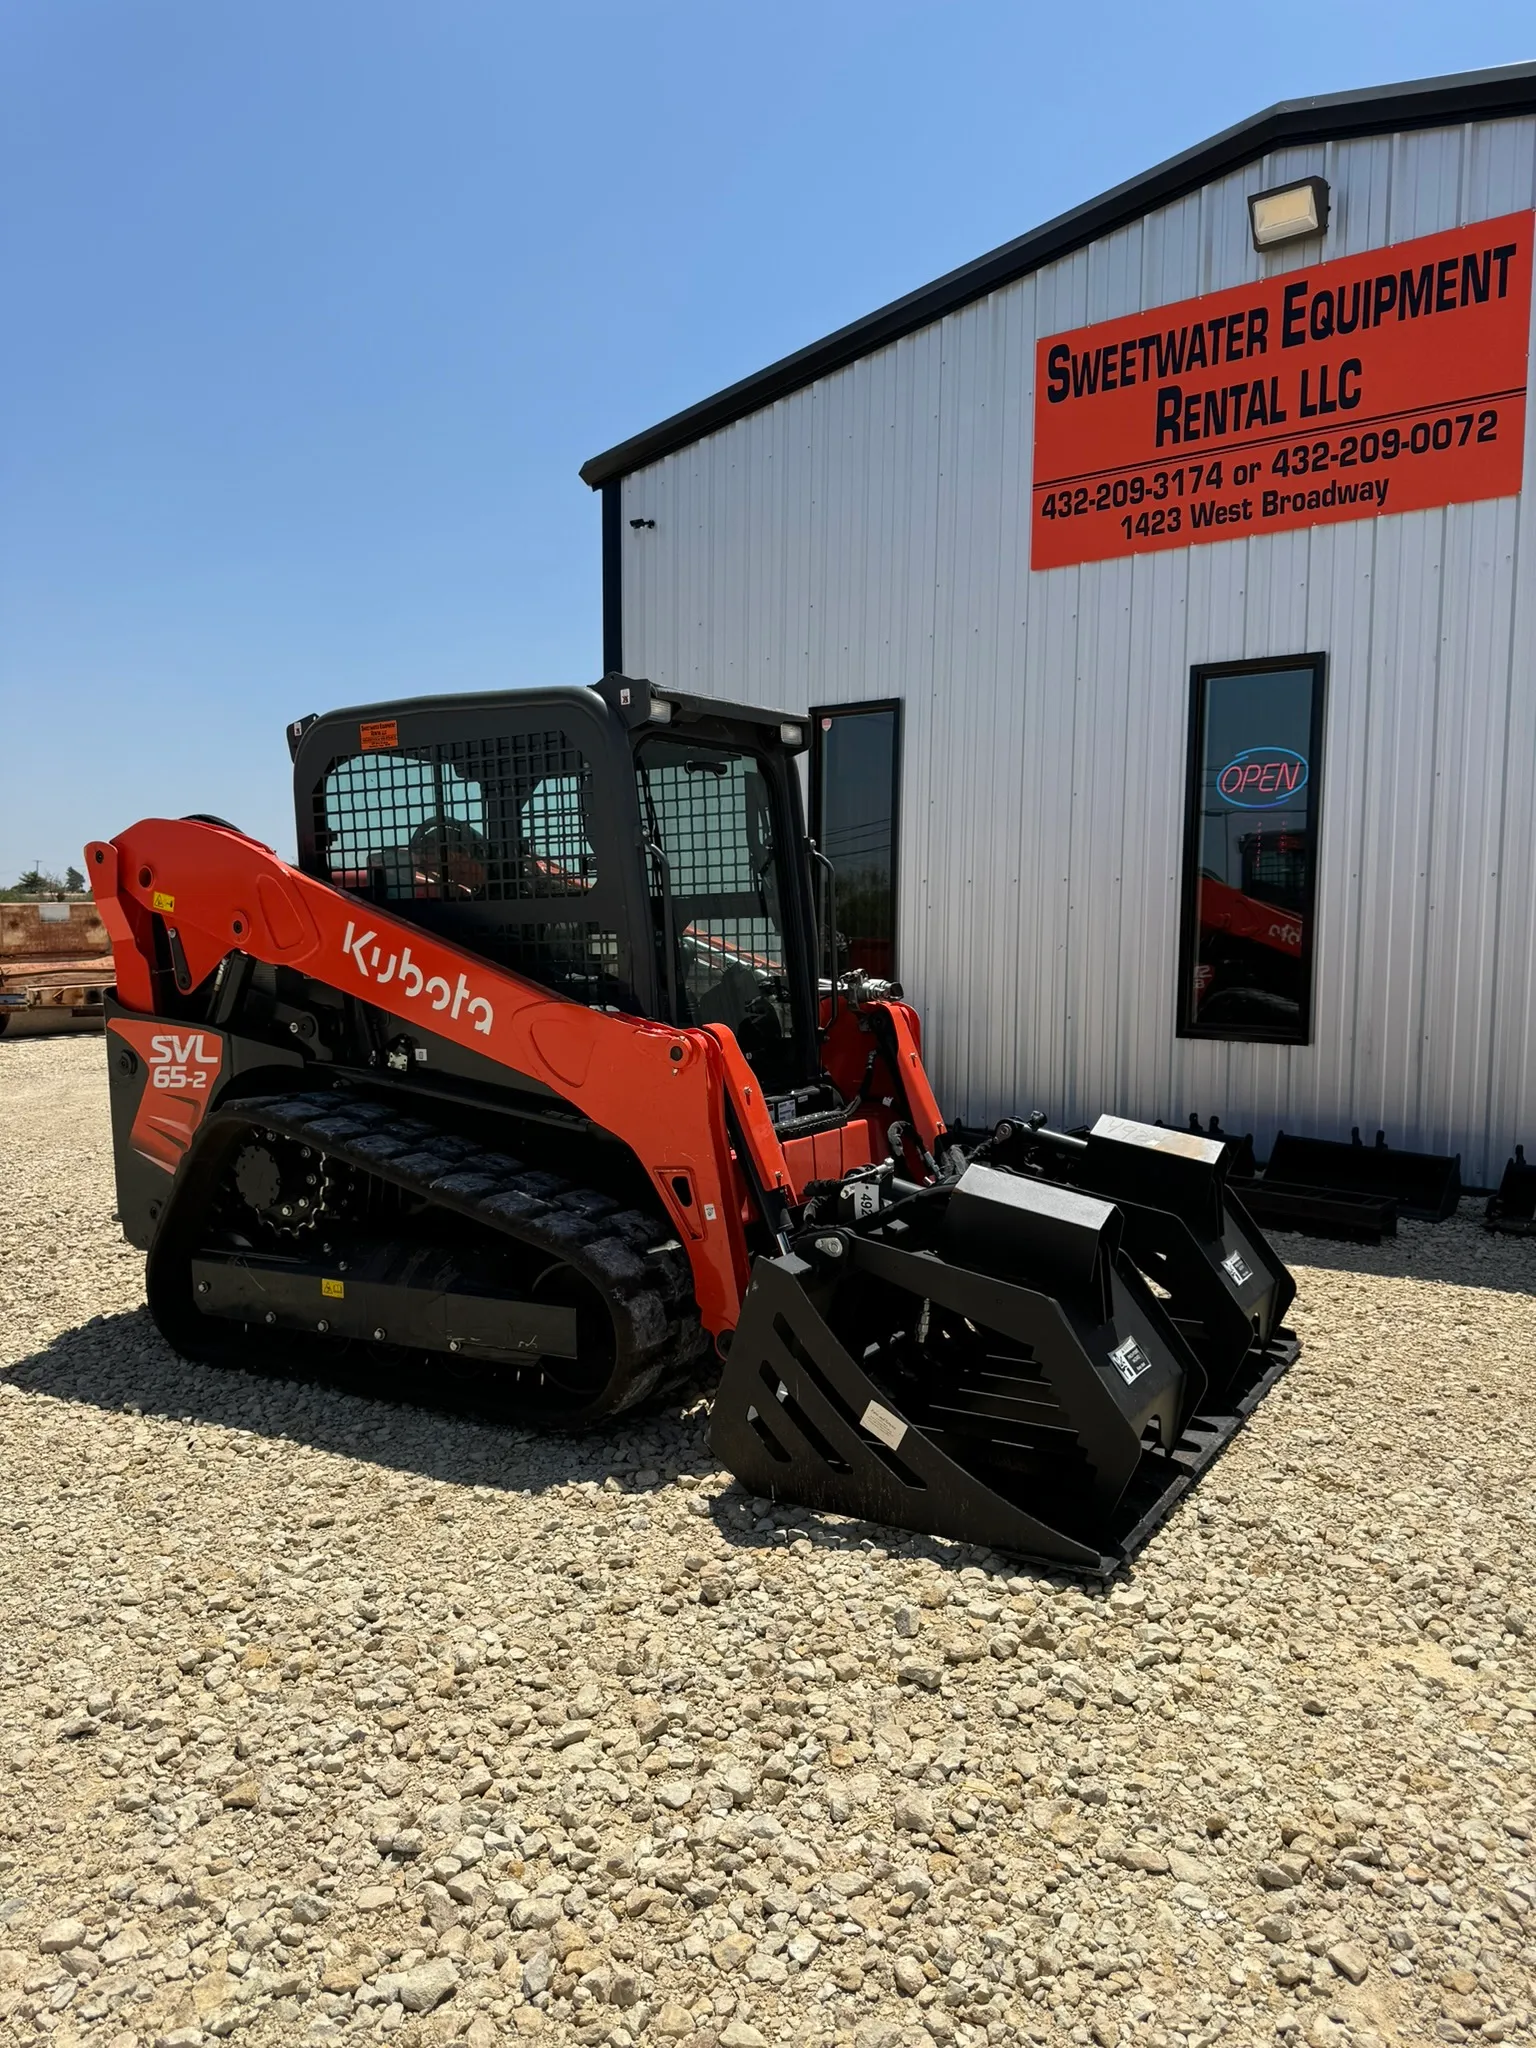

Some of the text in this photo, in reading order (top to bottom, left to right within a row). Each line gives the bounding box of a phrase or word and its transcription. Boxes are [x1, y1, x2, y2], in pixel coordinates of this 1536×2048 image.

[1047, 243, 1517, 404] SWEETWATER EQUIPMENT
[1156, 357, 1362, 448] RENTAL LLC
[1042, 410, 1498, 520] 432-209-3174 or 432-209-0072
[1121, 478, 1390, 540] 1423 West Broadway
[1221, 761, 1301, 794] OPEN
[343, 920, 494, 1036] Kubota
[150, 1035, 218, 1064] SVL
[153, 1065, 207, 1088] 65-2
